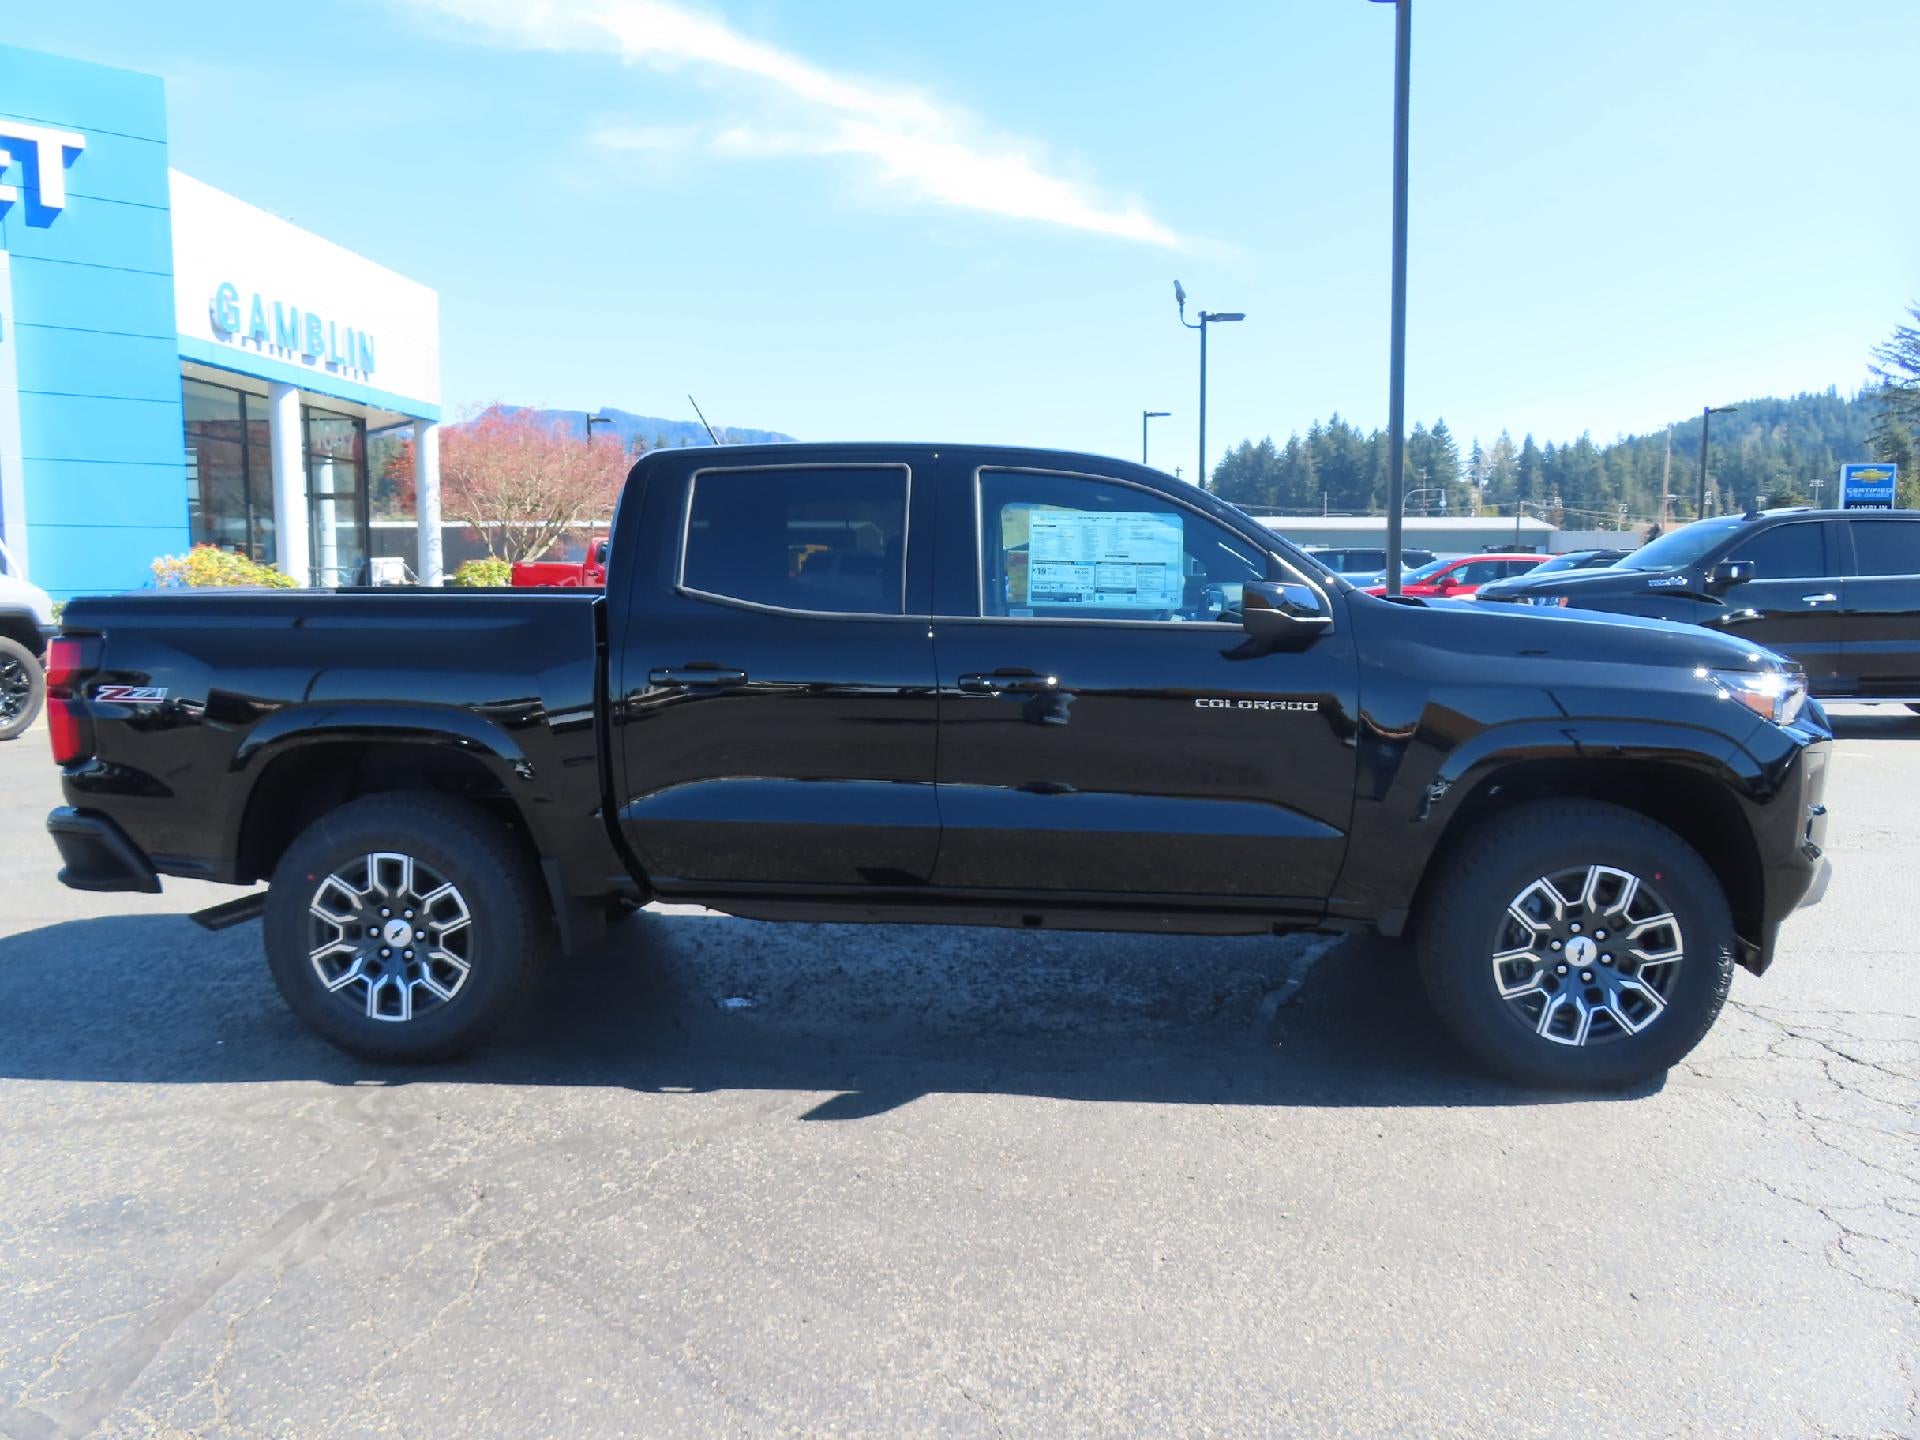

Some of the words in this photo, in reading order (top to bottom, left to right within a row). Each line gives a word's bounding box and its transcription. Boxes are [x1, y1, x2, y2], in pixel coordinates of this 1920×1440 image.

[0, 119, 86, 209] T
[213, 281, 377, 375] GAMBLIN
[1194, 698, 1319, 712] COLORADO
